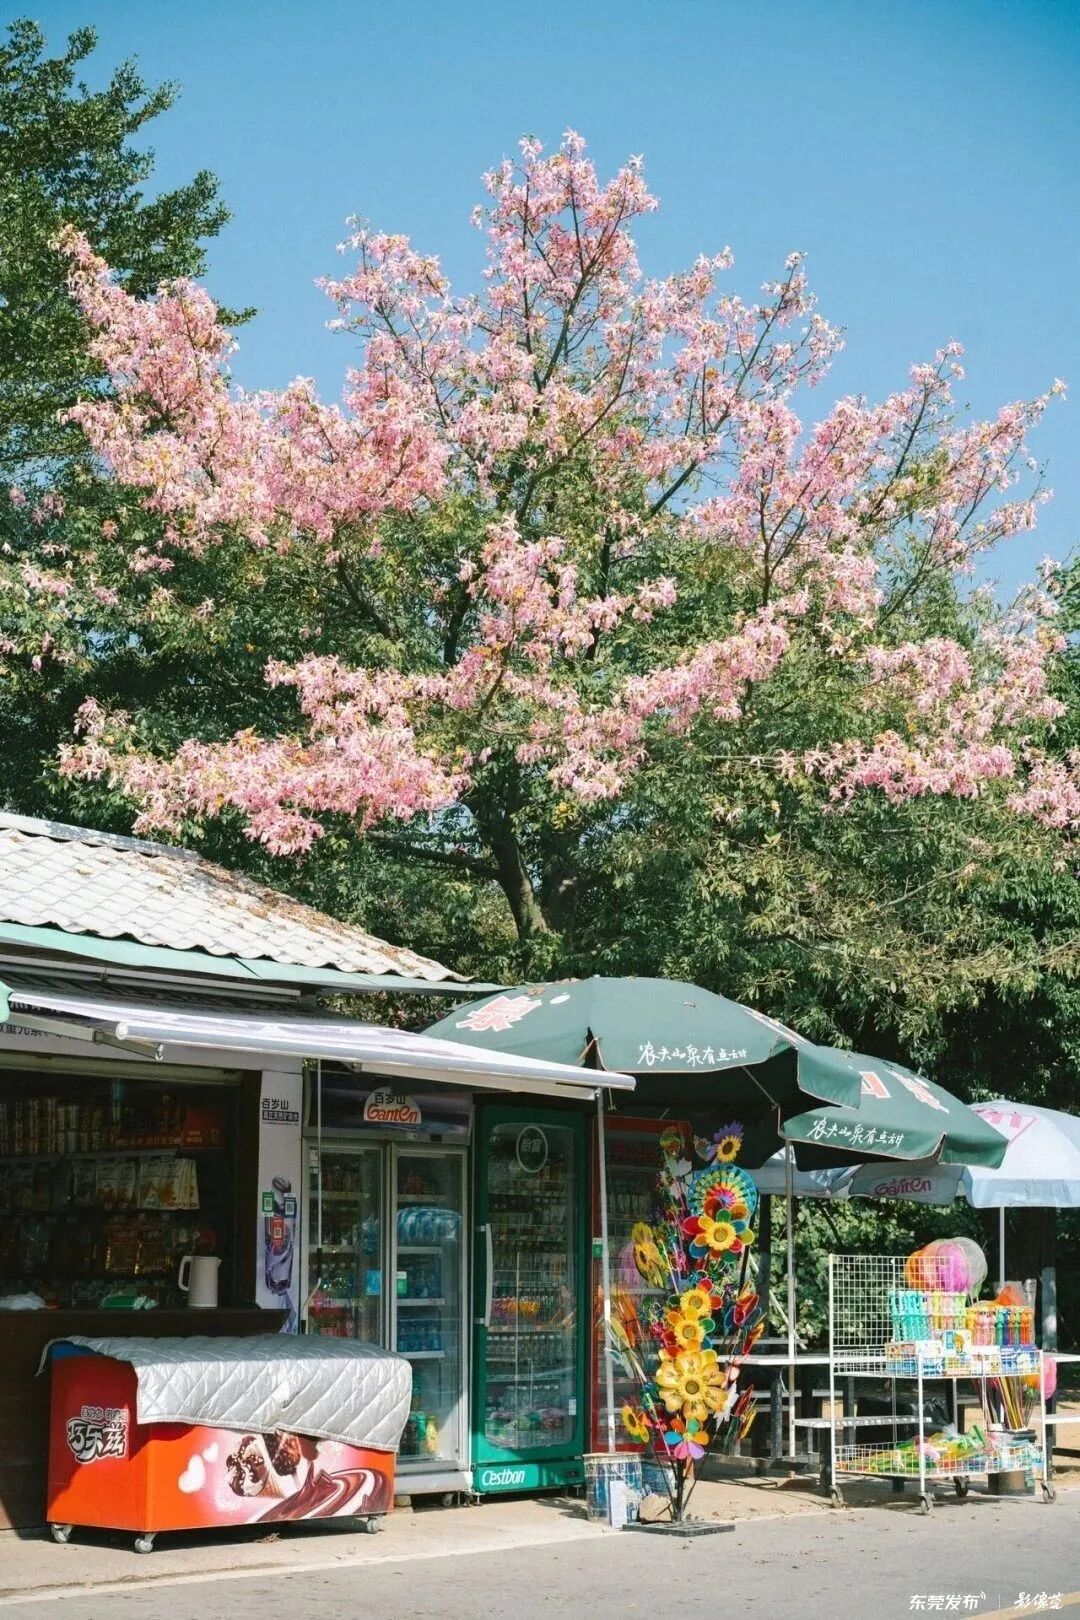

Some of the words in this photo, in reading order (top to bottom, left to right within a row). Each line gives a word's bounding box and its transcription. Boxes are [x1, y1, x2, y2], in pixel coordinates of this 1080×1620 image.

[637, 1041, 748, 1068] 农夫山泉有点甜
[262, 1097, 289, 1110] 百岁山
[374, 1091, 406, 1105] 百岁山
[806, 1116, 905, 1148] 农夫山泉有点甜
[68, 1418, 127, 1462] 巧乐兹
